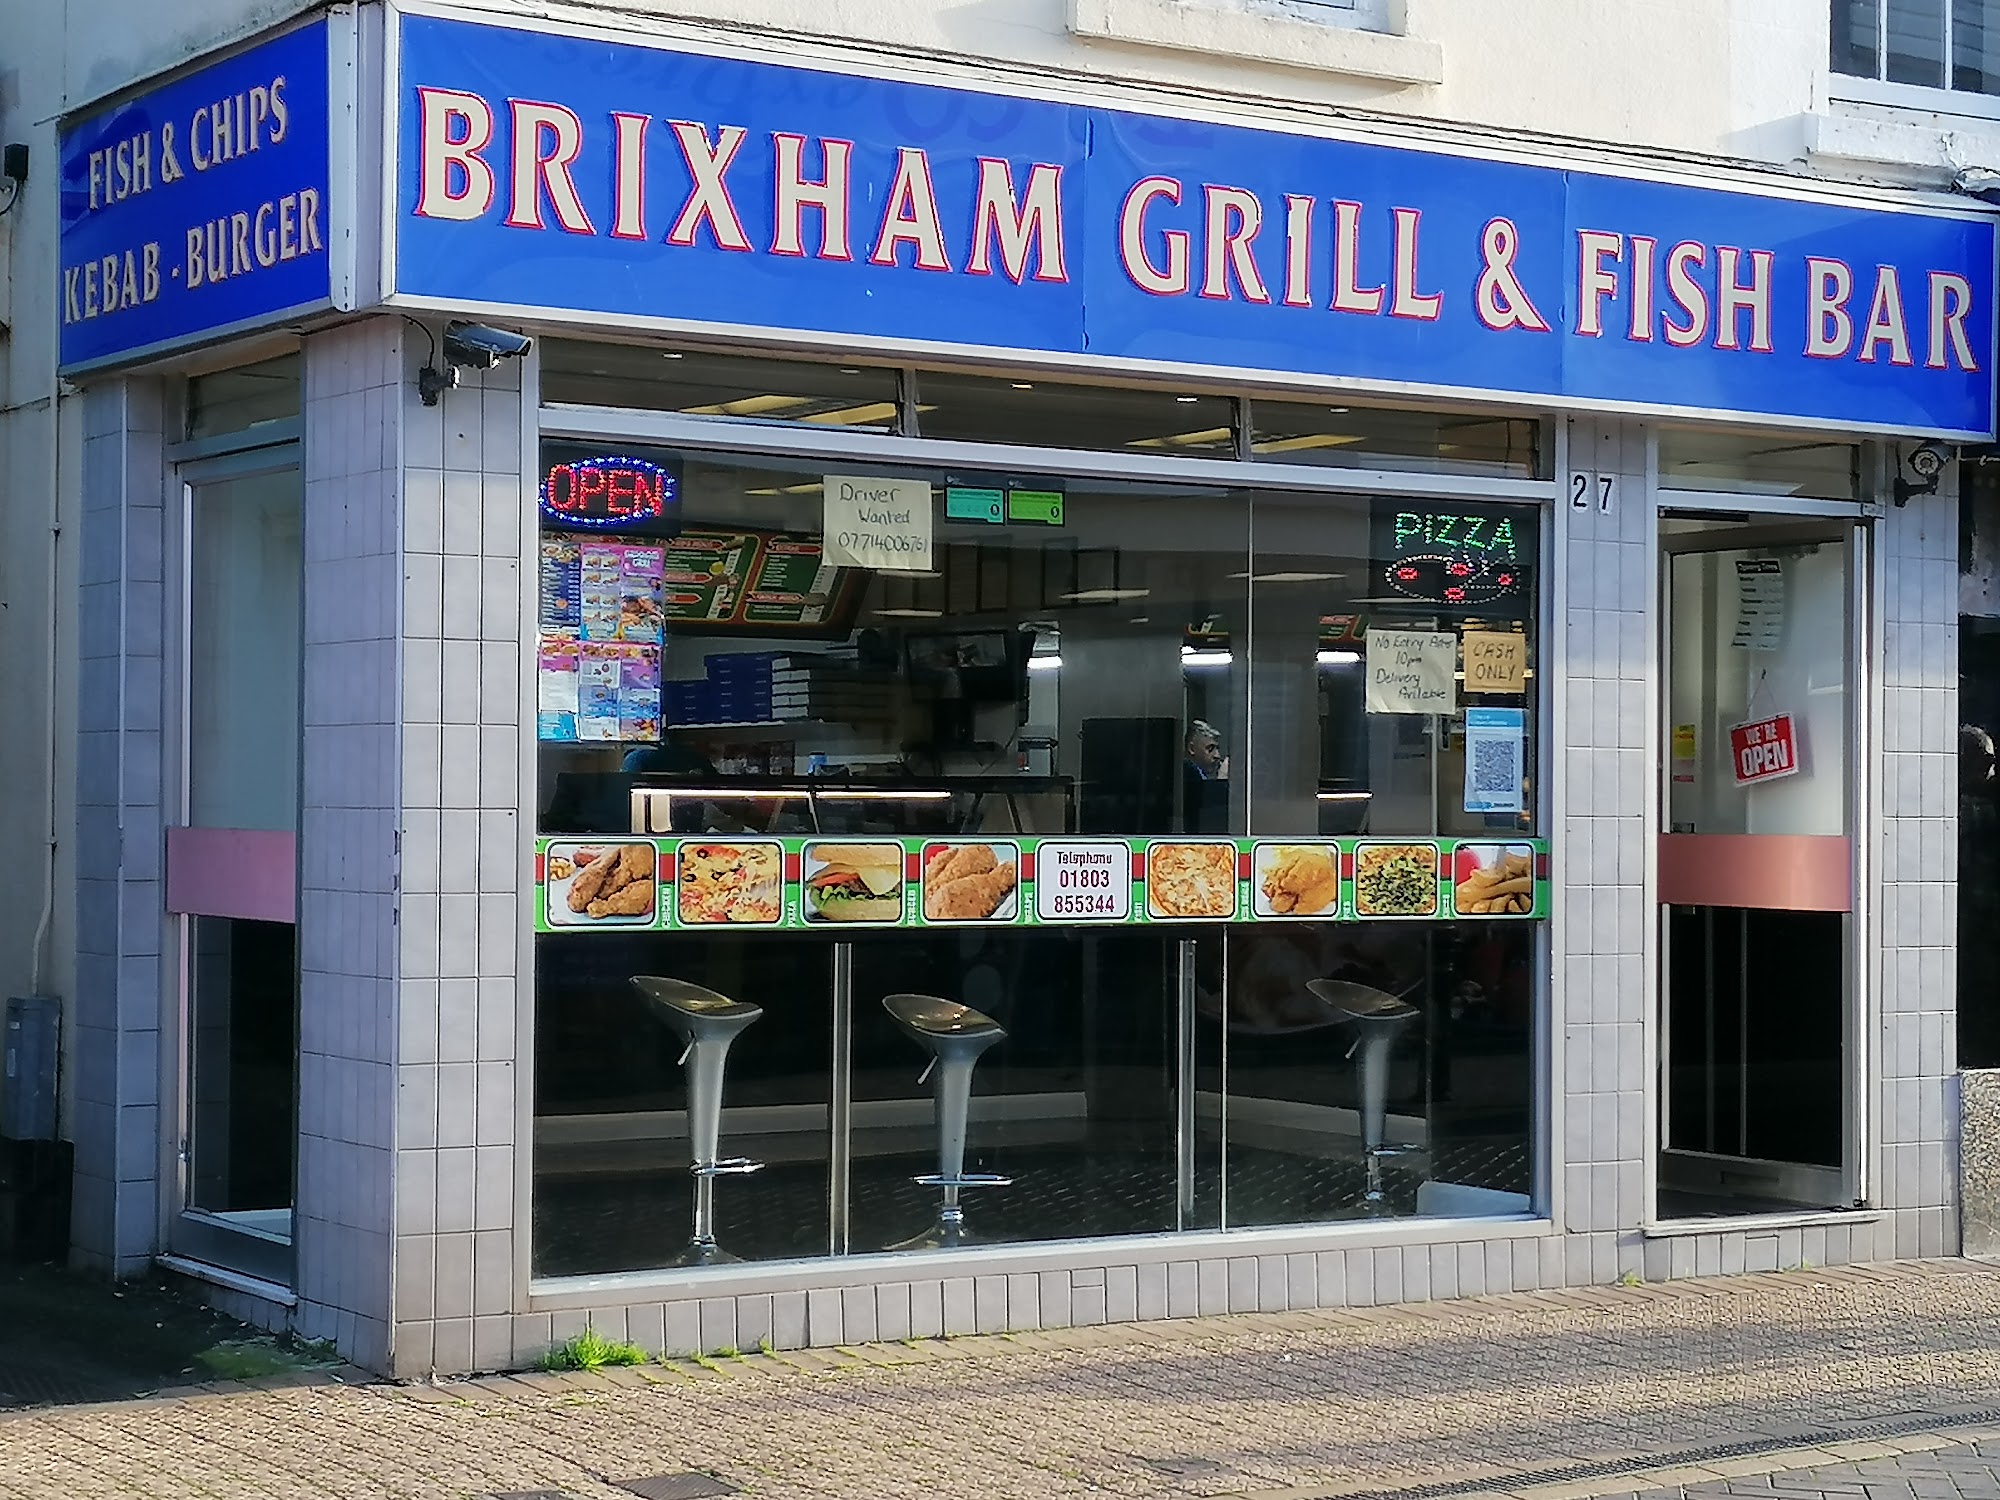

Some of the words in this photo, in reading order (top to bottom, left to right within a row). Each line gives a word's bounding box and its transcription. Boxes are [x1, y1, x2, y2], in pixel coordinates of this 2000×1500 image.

[89, 131, 151, 210] FISH
[160, 121, 184, 184] &
[190, 75, 289, 172] CHIPS
[413, 84, 1069, 286] BRIXHAM
[1119, 175, 1444, 322] GRILL
[1476, 215, 1552, 332] &
[1575, 227, 1776, 354] FISH
[1803, 256, 1981, 373] BAR
[64, 241, 161, 324] KEBAB
[187, 186, 323, 289] BURGER
[548, 463, 663, 516] OPEN
[840, 482, 901, 504] Driver
[1573, 474, 1612, 510] 27
[858, 508, 910, 524] Wanted
[1394, 511, 1517, 561] PIZZA
[1473, 641, 1516, 660] CASH
[1376, 667, 1421, 689] Delivery
[1475, 663, 1516, 682] ONLY
[1741, 738, 1789, 777] OPEN
[1060, 869, 1110, 888] 01803
[1054, 894, 1115, 914] 855344
